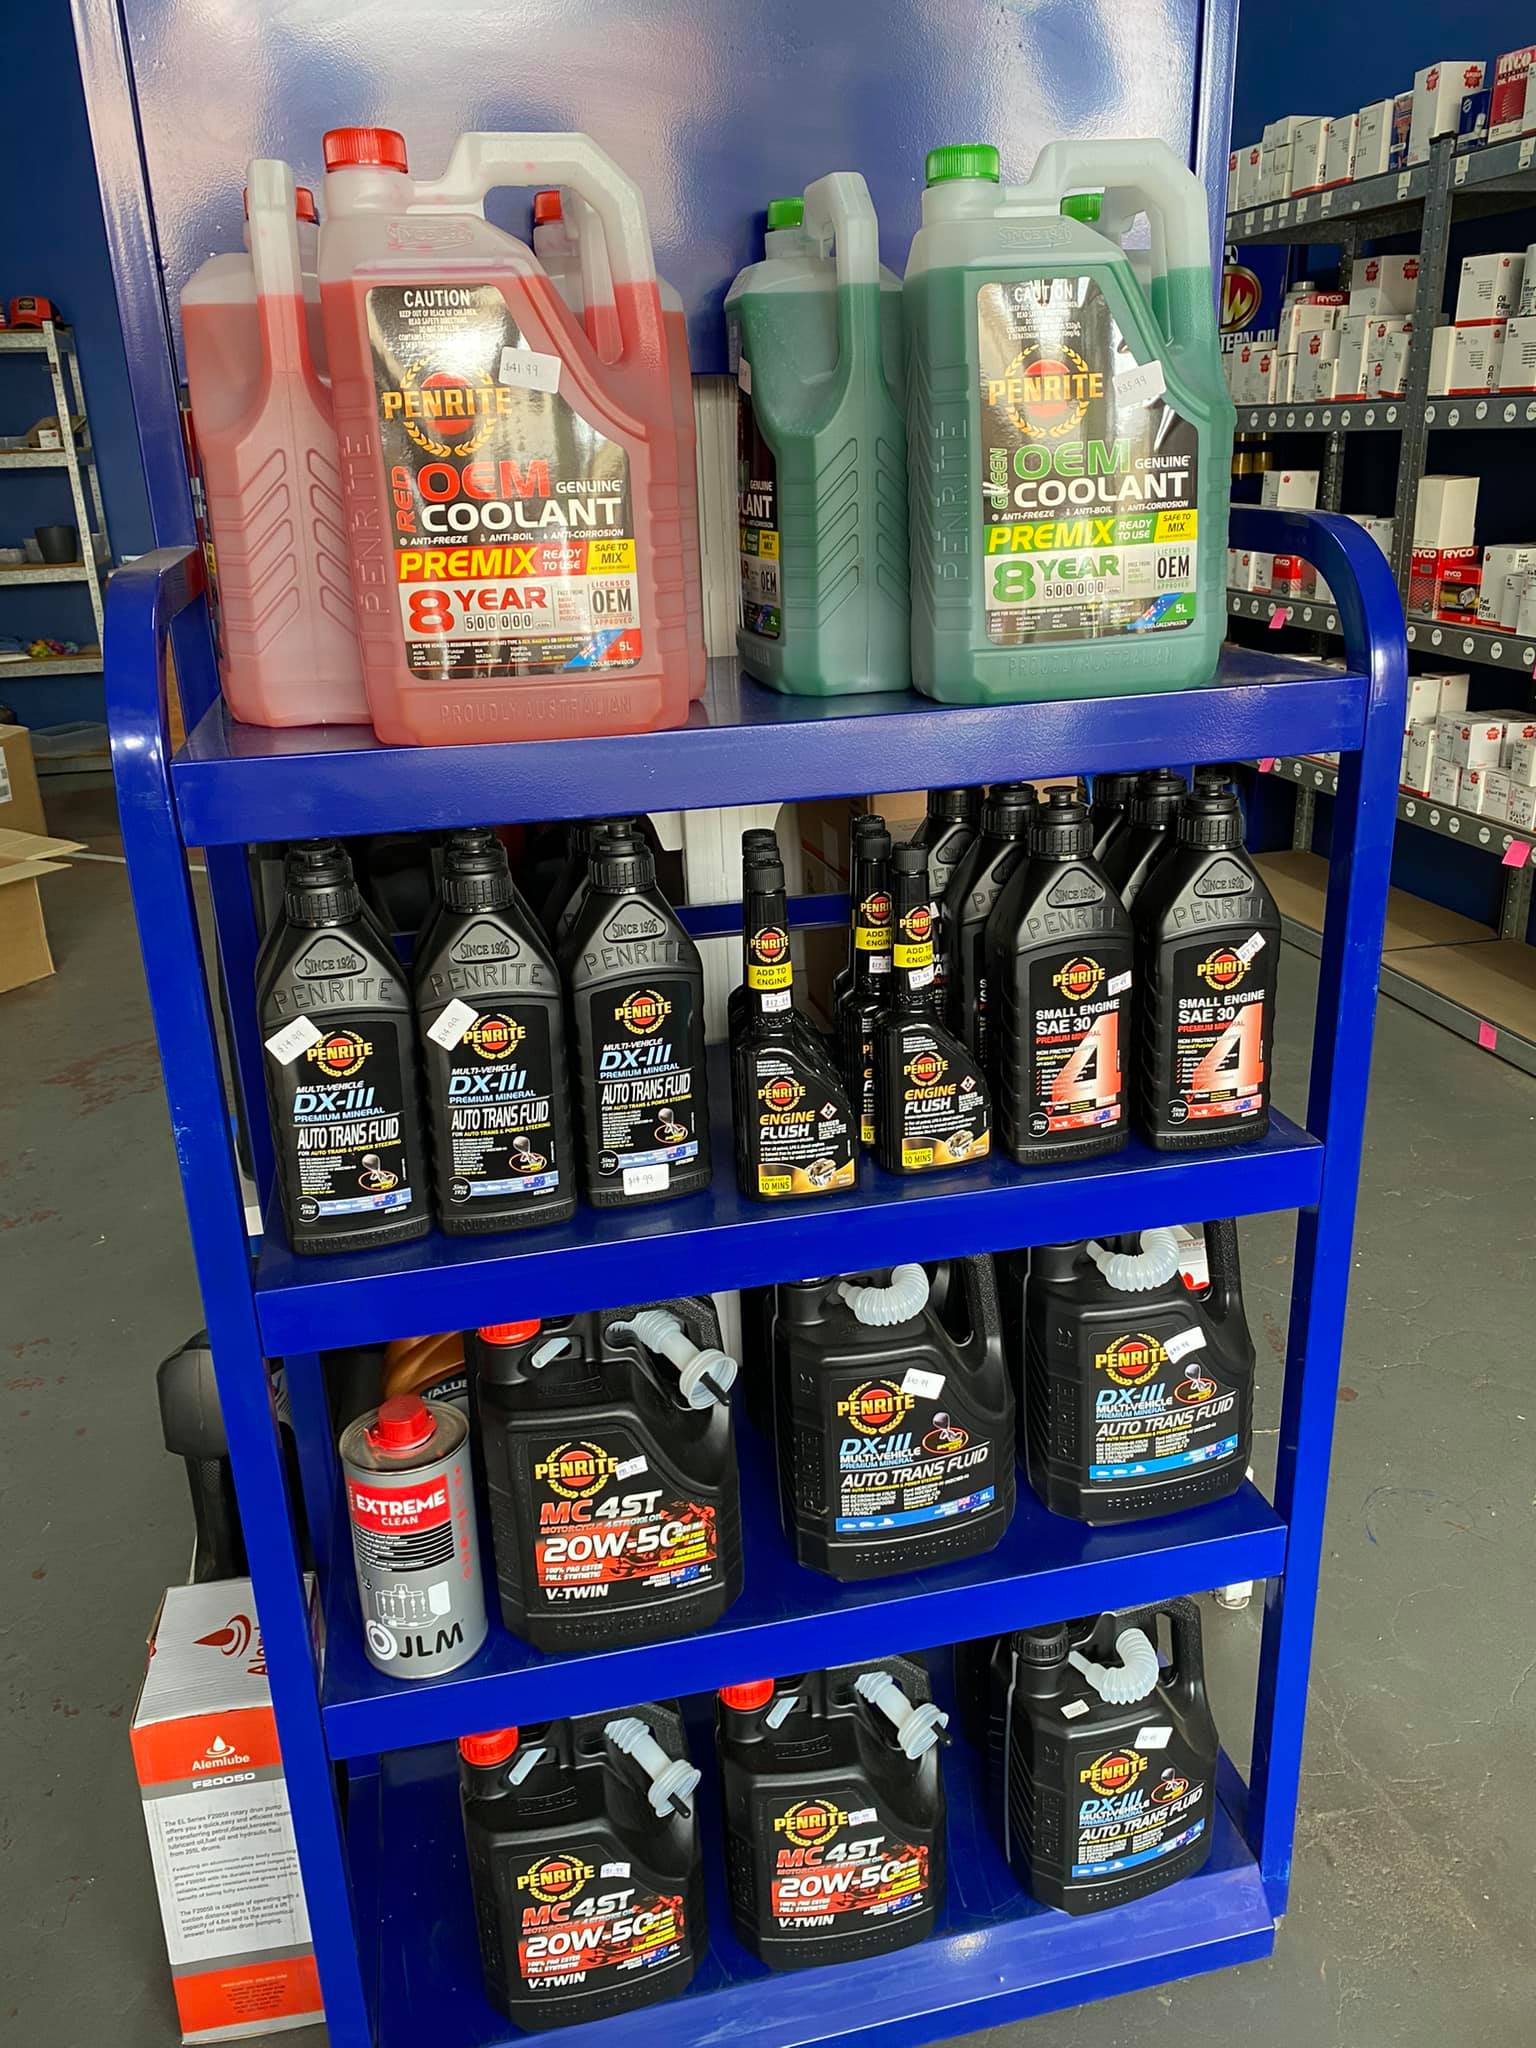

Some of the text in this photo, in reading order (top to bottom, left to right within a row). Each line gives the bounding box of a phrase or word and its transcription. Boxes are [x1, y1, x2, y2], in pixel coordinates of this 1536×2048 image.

[404, 289, 470, 307] CAUTION
[1317, 294, 1343, 304] RYCO
[988, 372, 1104, 406] PENRITE
[383, 387, 512, 419] PENRITE
[1013, 439, 1132, 479] OEM
[1134, 455, 1189, 470] GENUINE
[417, 459, 551, 502] OEM
[1013, 471, 1189, 507] COOLANT
[391, 465, 417, 533] RED
[421, 497, 622, 532] COOLANT
[1001, 501, 1188, 521] ANTI-FREEZE ANTI-BOIL ANTI-CORROSION
[1163, 514, 1181, 522] SAFE
[1118, 519, 1152, 530] READY
[1168, 523, 1185, 532] MIX
[410, 528, 624, 546] ANTI-FREEZE ANTI-BOIL ANTI-CORROSION
[988, 518, 1116, 553] PREMIX
[1117, 530, 1150, 540] TO USE
[542, 549, 582, 559] READY
[594, 543, 628, 552] SAFE TO
[1412, 549, 1437, 558] RYCO
[1443, 548, 1474, 559] RYCO
[400, 546, 538, 580] PREMIX
[542, 560, 580, 570] TO USE
[601, 553, 622, 564] MIX
[1036, 555, 1120, 581] YEAR
[1157, 555, 1190, 579] OEM
[591, 580, 630, 589] LICENSED
[992, 560, 1036, 602] 8
[1045, 581, 1104, 598] 500 000
[453, 587, 548, 613] YEAR
[592, 589, 632, 614] OEM
[1176, 604, 1188, 613] 5L
[408, 589, 455, 634] 8
[464, 612, 533, 632] 500 000
[619, 642, 633, 651] 5L
[611, 919, 658, 938] SINCE 1926
[460, 940, 510, 959] SINCE 1926
[751, 936, 789, 948] PENRITE
[304, 954, 357, 975] SINCE 1926
[1197, 960, 1252, 976] PENRITE
[430, 963, 544, 997] PENRITE
[756, 977, 787, 986] ENGINE
[1052, 968, 1105, 987] PENRITE
[272, 978, 394, 1015] PENRITE
[1178, 989, 1265, 1009] SMALL ENGINE
[614, 1001, 672, 1020] PENRITE
[1036, 999, 1120, 1020] SMALL ENGINE
[1178, 1006, 1235, 1024] SAE 30
[463, 1026, 527, 1044] PENRITE
[1036, 1016, 1091, 1035] SAE 30
[1178, 1023, 1213, 1033] PREMIUM
[1036, 1034, 1070, 1045] PREMIUM
[307, 1042, 373, 1062] PENRITE
[600, 1043, 672, 1071] DX-III
[451, 1063, 517, 1075] MULTI-VEHICLE
[600, 1063, 680, 1079] PREMIUM MINERAL
[904, 1060, 948, 1076] PENRITE
[296, 1080, 364, 1094] MULTI-VEHICLE
[449, 1070, 527, 1095] DX-III
[601, 1073, 691, 1105] AUTO TRANS FLUID
[904, 1084, 956, 1100] ENGINE
[293, 1087, 375, 1114] DX-III
[449, 1090, 536, 1104] PREMIUM MINERAL
[757, 1086, 806, 1099] PENRITE
[294, 1107, 385, 1122] PREMIUM MINERAL
[904, 1097, 952, 1114] FLUSH
[451, 1101, 549, 1130] AUTO TRANS FLUID
[760, 1110, 815, 1125] ENGINE
[298, 1117, 399, 1150] AUTO TRANS FLUID
[760, 1124, 810, 1140] FLUSH
[905, 1154, 931, 1164] 10 MINS
[771, 1181, 790, 1190] MINS
[1095, 1347, 1168, 1369] PENRITE
[1096, 1383, 1166, 1406] DX-III
[837, 1394, 915, 1416] PENRITE
[1096, 1396, 1173, 1413] MULTI-VEHICLE
[1096, 1397, 1234, 1437] AUTO TRANS FLUID
[839, 1432, 912, 1456] DX-III
[839, 1447, 920, 1464] MULTI-VEHICLE
[534, 1457, 619, 1480] PENRITE
[841, 1447, 988, 1488] AUTO TRANS FLUID
[356, 1489, 446, 1516] EXTREME
[539, 1490, 663, 1525] MC 4ST
[381, 1515, 419, 1526] CLEAN
[543, 1521, 683, 1563] 20W-50
[699, 1565, 711, 1573] 4L
[545, 1584, 609, 1600] V-TWIN
[399, 1622, 464, 1658] JLM
[192, 1754, 250, 1771] Alemlube
[1080, 1757, 1149, 1783] PENRITE
[192, 1772, 256, 1789] F20050
[1079, 1788, 1144, 1815] DX-III
[774, 1811, 849, 1832] PENRITE
[1079, 1787, 1203, 1841] AUTO TRANS FLUID
[776, 1836, 885, 1868] MC 4ST
[517, 1865, 595, 1890] PENRITE
[778, 1860, 901, 1898] 20W-50
[522, 1889, 635, 1927] MC 4ST
[779, 1915, 834, 1928] V-TWIN
[525, 1913, 654, 1958] 20W-50
[528, 1972, 586, 1988] V-TWIN
